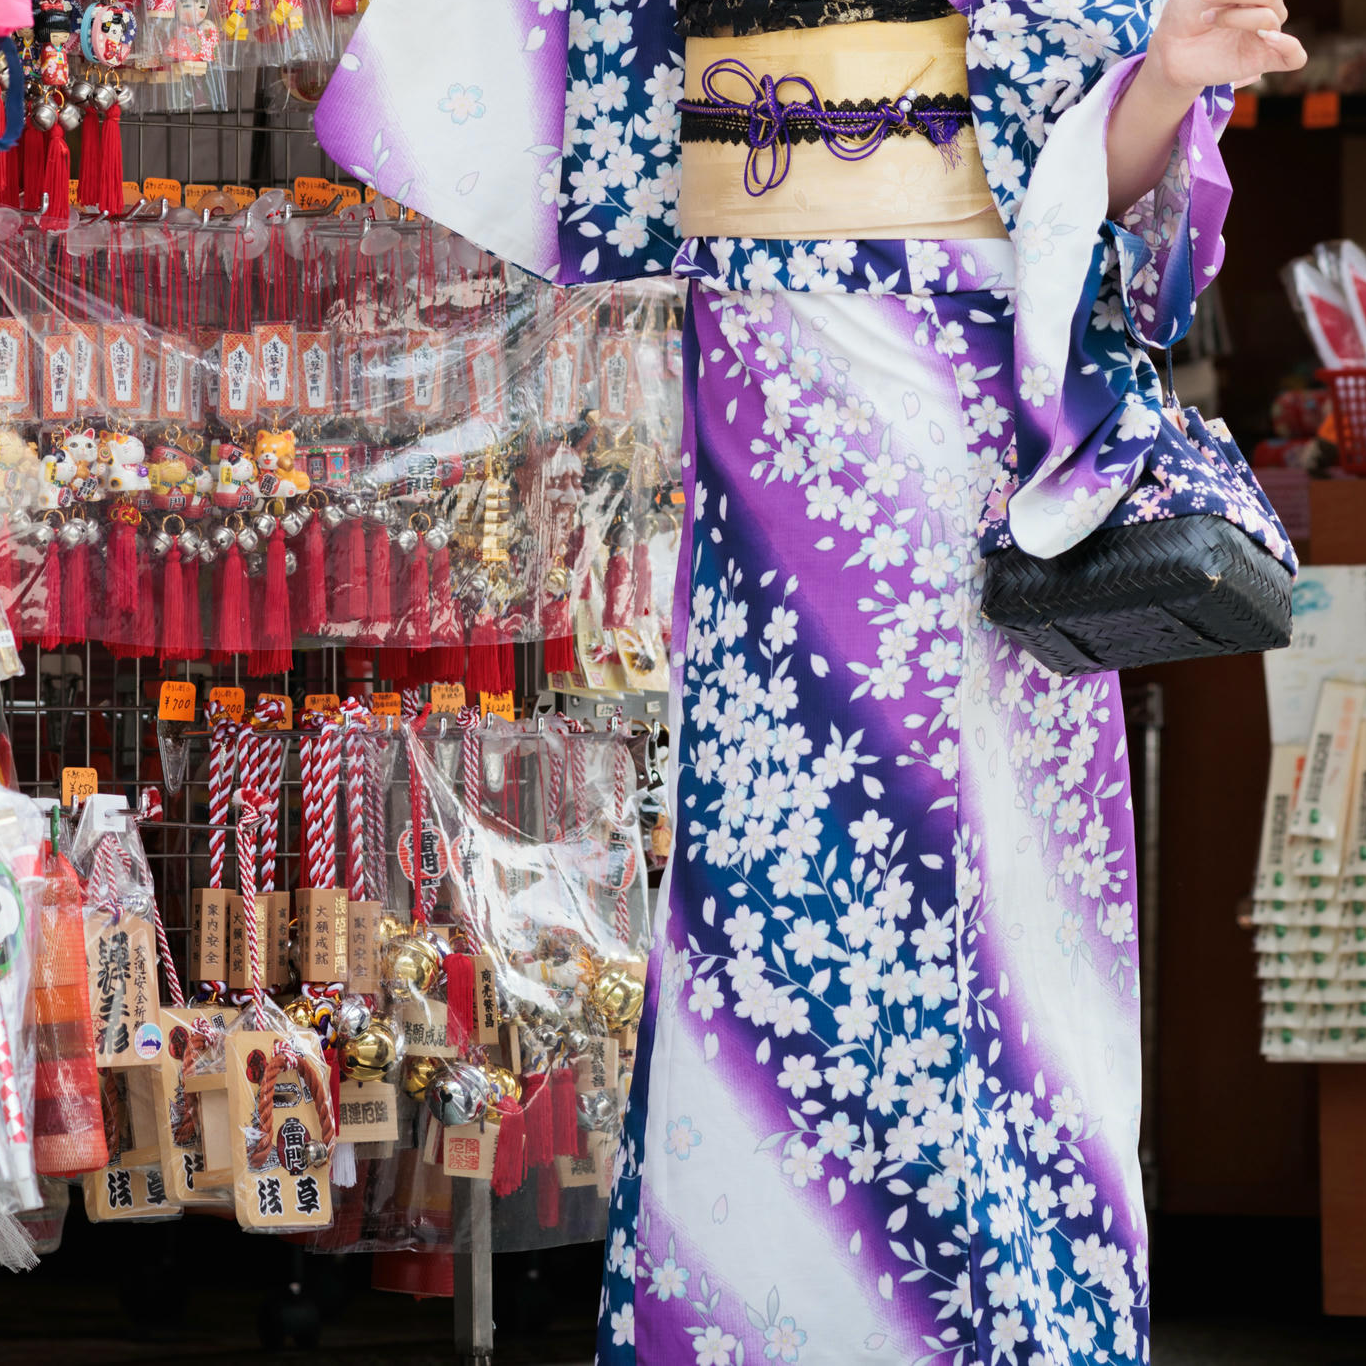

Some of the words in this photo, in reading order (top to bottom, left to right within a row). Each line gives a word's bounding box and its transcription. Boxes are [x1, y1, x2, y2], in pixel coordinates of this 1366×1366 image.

[52, 349, 67, 403] 浅草雷門
[115, 340, 128, 393] 浅草雷門
[231, 348, 244, 402] 浅草雷門
[268, 340, 281, 392] 浅草雷門
[309, 346, 321, 399] 浅草雷門
[165, 695, 191, 711] ¥700
[69, 782, 95, 797] ¥550
[205, 903, 220, 966] 家内安全
[314, 903, 330, 966] 大願成就
[352, 915, 369, 979] 家内安全
[480, 969, 495, 1029] 商売繁昌
[283, 1121, 307, 1172] 雷門
[107, 1169, 170, 1211] 浅草
[257, 1175, 322, 1217] 浅草
